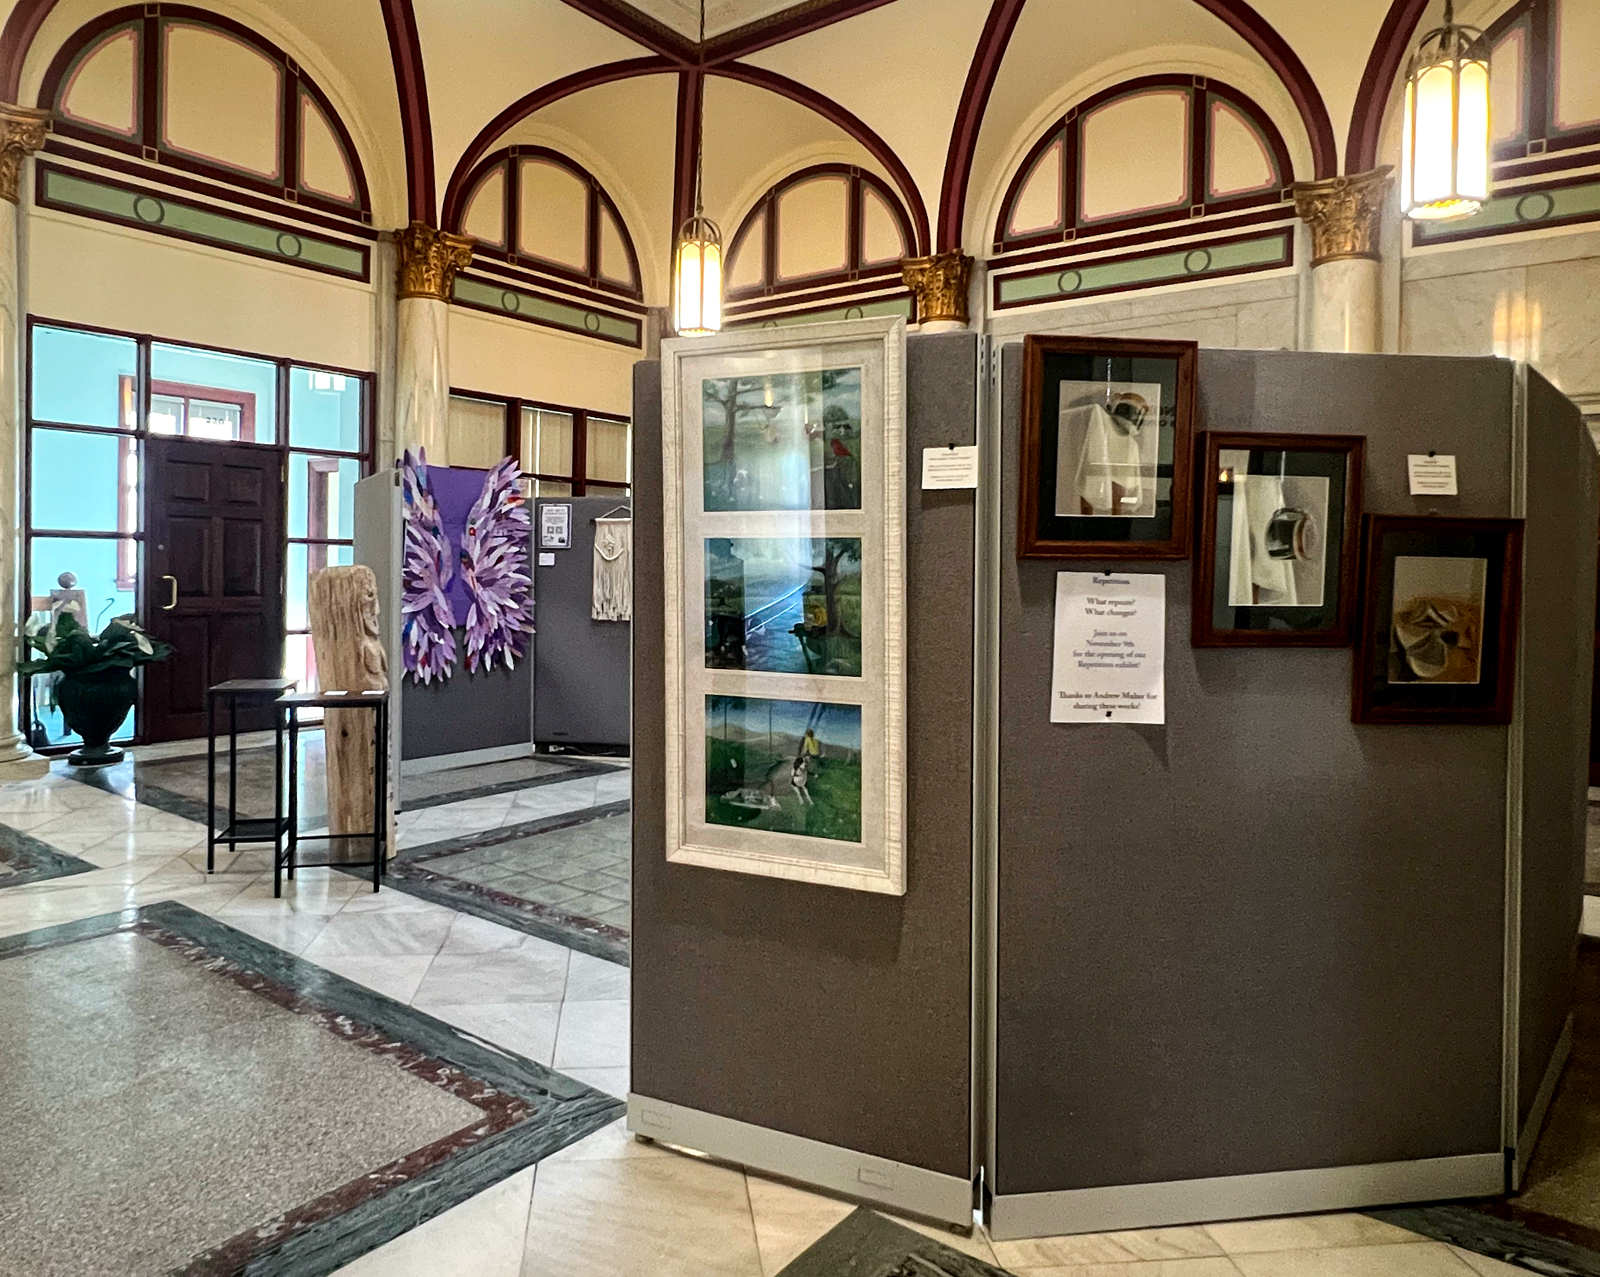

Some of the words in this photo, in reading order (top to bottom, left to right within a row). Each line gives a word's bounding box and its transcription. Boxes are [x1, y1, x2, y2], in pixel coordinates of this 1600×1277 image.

[1093, 576, 1130, 586] Repetition
[1087, 597, 1107, 605] What
[1085, 607, 1105, 615] What
[1107, 609, 1137, 618] changes?
[1093, 629, 1108, 638] Join
[1086, 640, 1121, 648] November
[1123, 640, 1135, 648] 9th
[1097, 651, 1125, 659] opening
[1126, 650, 1134, 658] of
[1078, 660, 1114, 669] Repetition
[1059, 691, 1083, 699] Thanks
[1093, 691, 1120, 699] Andrew
[1146, 692, 1158, 700] for
[1073, 702, 1098, 711] sharing
